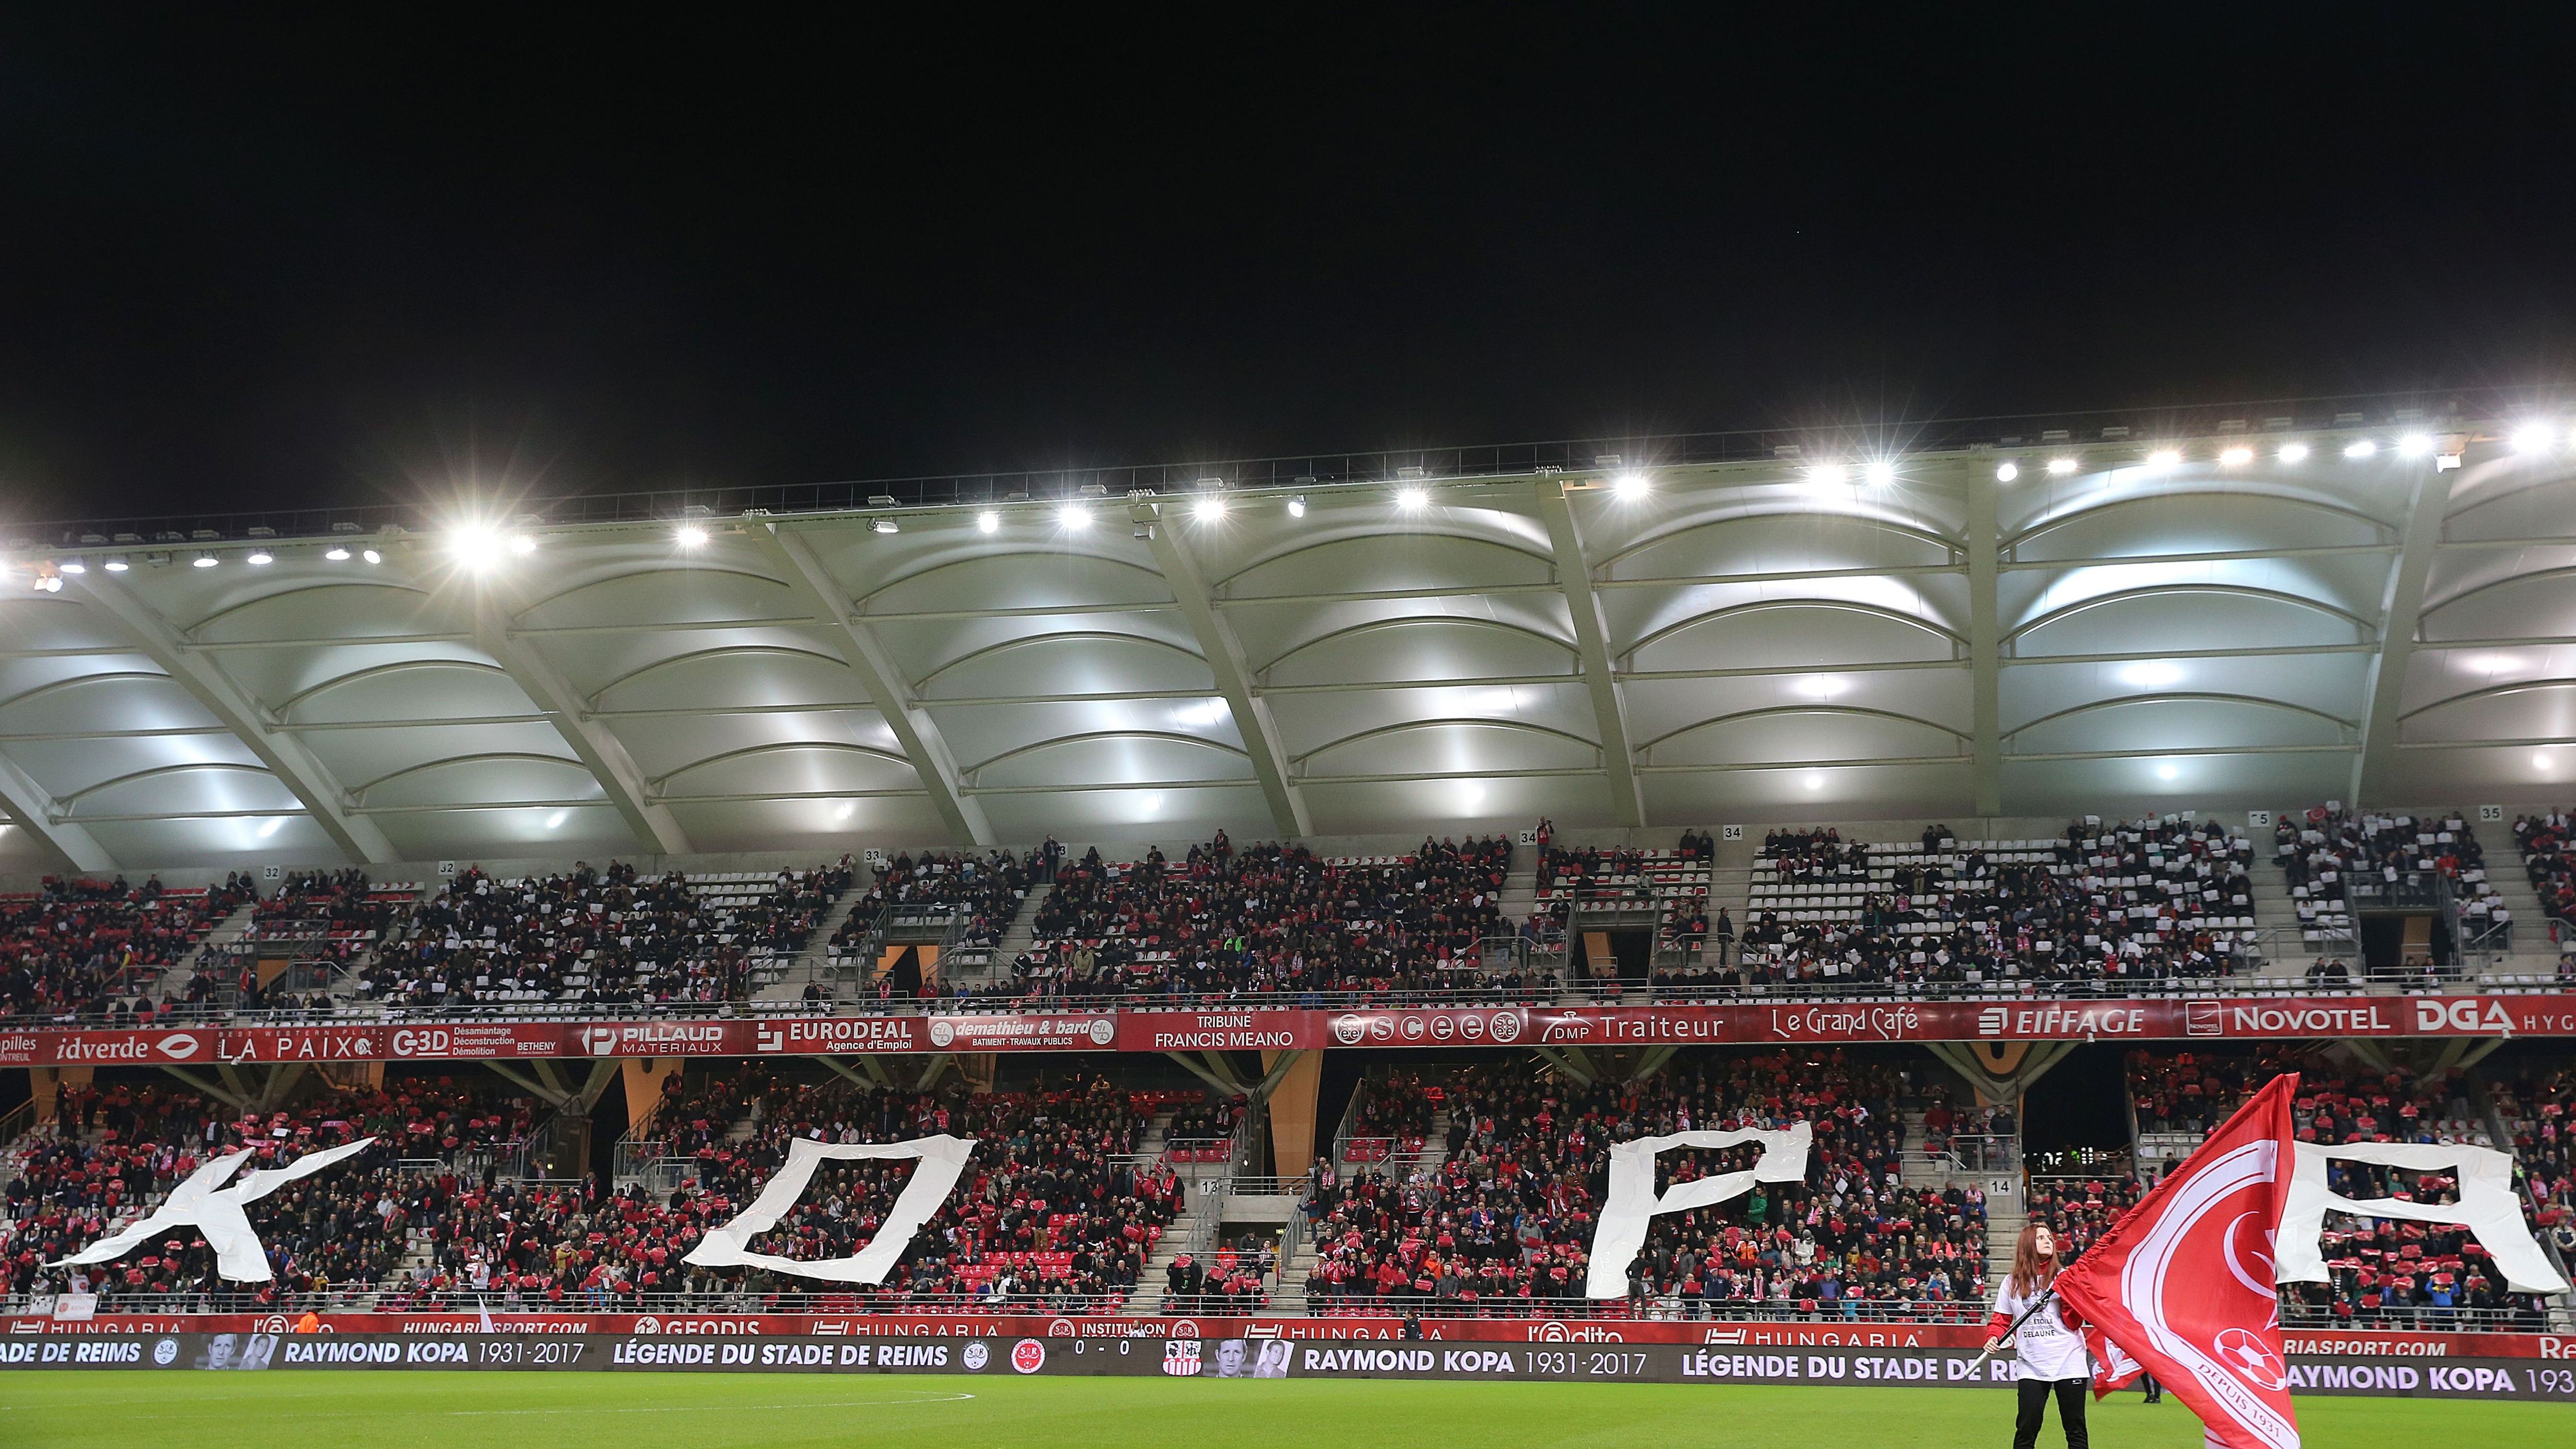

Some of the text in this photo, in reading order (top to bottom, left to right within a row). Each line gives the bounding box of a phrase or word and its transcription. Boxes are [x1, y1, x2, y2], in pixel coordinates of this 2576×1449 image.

[2482, 808, 2499, 817] 35
[1522, 833, 1536, 843] 34
[1726, 832, 1740, 843] 34
[866, 850, 879, 861] 33
[266, 868, 279, 877] 32
[1197, 1016, 1251, 1028] TRIBUNE
[1772, 1006, 1918, 1040] Le Grand Café
[2016, 1009, 2145, 1034] EIFFAGE
[2234, 1006, 2391, 1031] NOVOTEL
[2416, 1000, 2516, 1031] DGA
[455, 1026, 511, 1037] Désamiantage
[623, 1026, 723, 1042] PILLAUD
[790, 1022, 912, 1040] EURODEAL
[955, 1021, 1033, 1036] demathieu
[1038, 1021, 1050, 1035] &
[1055, 1020, 1091, 1035] bard
[1555, 1028, 1589, 1039] DMP
[1599, 1016, 1723, 1037] Traiteur
[0, 1036, 36, 1054] pilles
[454, 1037, 514, 1045] Déconstruction
[517, 1042, 555, 1051] BETHENY
[826, 1040, 912, 1052] Agence d'Emploi
[972, 1037, 1073, 1046] BATIMENT TRAVAUX PUBLICS
[1155, 1031, 1293, 1047] FRANCIS MEANO
[57, 1036, 148, 1059] idverde
[221, 1038, 257, 1059] LA
[277, 1036, 353, 1058] PAIX
[453, 1046, 495, 1056] Démolition
[1203, 1181, 1217, 1192] 13
[1992, 1182, 2009, 1193] 14
[666, 1320, 759, 1335] GEODIS
[1082, 1323, 1165, 1334] INSTITUON
[1291, 1327, 1442, 1340] HUNGARA
[2024, 1330, 2055, 1338] DELAUNE
[0, 1342, 142, 1363] ADE DE REIMS
[285, 1342, 401, 1363] RAYMOND
[407, 1342, 468, 1363] KOPA
[613, 1337, 715, 1364] LÉGENDE
[721, 1344, 755, 1365] DU
[761, 1344, 834, 1365] STADE
[840, 1345, 871, 1365] DE
[878, 1346, 948, 1366] REIMS
[1075, 1339, 1085, 1354] 0
[1119, 1340, 1129, 1355] 0
[1304, 1349, 1435, 1371] RAYMOND
[1443, 1350, 1515, 1373] KOPA
[1682, 1348, 1799, 1378] LÉGENDE
[1808, 1356, 1846, 1378] DU
[1854, 1356, 1938, 1380] STADE
[1947, 1358, 1981, 1381] DE
[2287, 1365, 2574, 1393] AYMOND KOPA 193
[2198, 1364, 2279, 1438] DEPUIS 1931
